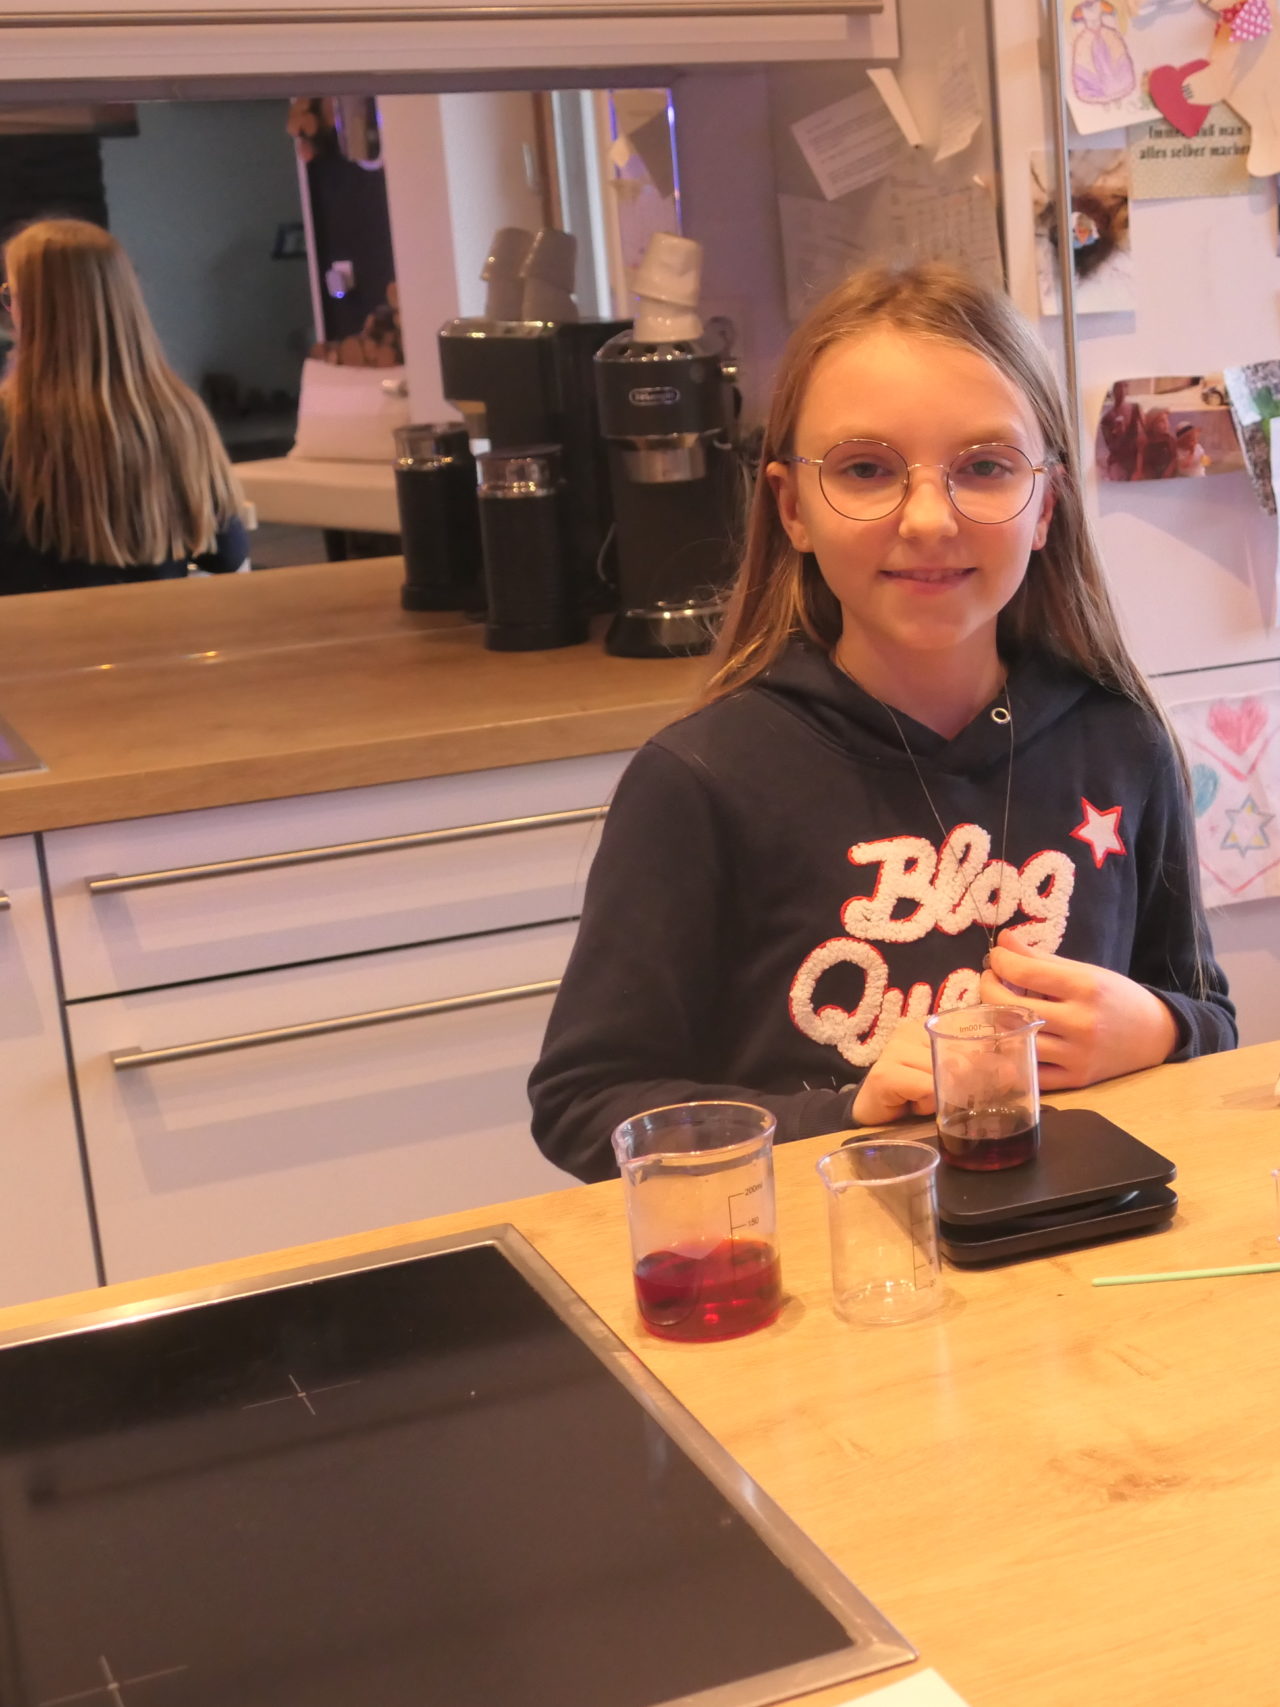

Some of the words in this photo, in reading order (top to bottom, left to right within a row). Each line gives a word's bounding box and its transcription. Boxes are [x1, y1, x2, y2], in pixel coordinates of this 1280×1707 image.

[1218, 126, 1243, 135] man
[1139, 145, 1168, 159] alles
[1170, 144, 1206, 158] selber
[840, 823, 1076, 956] Blog
